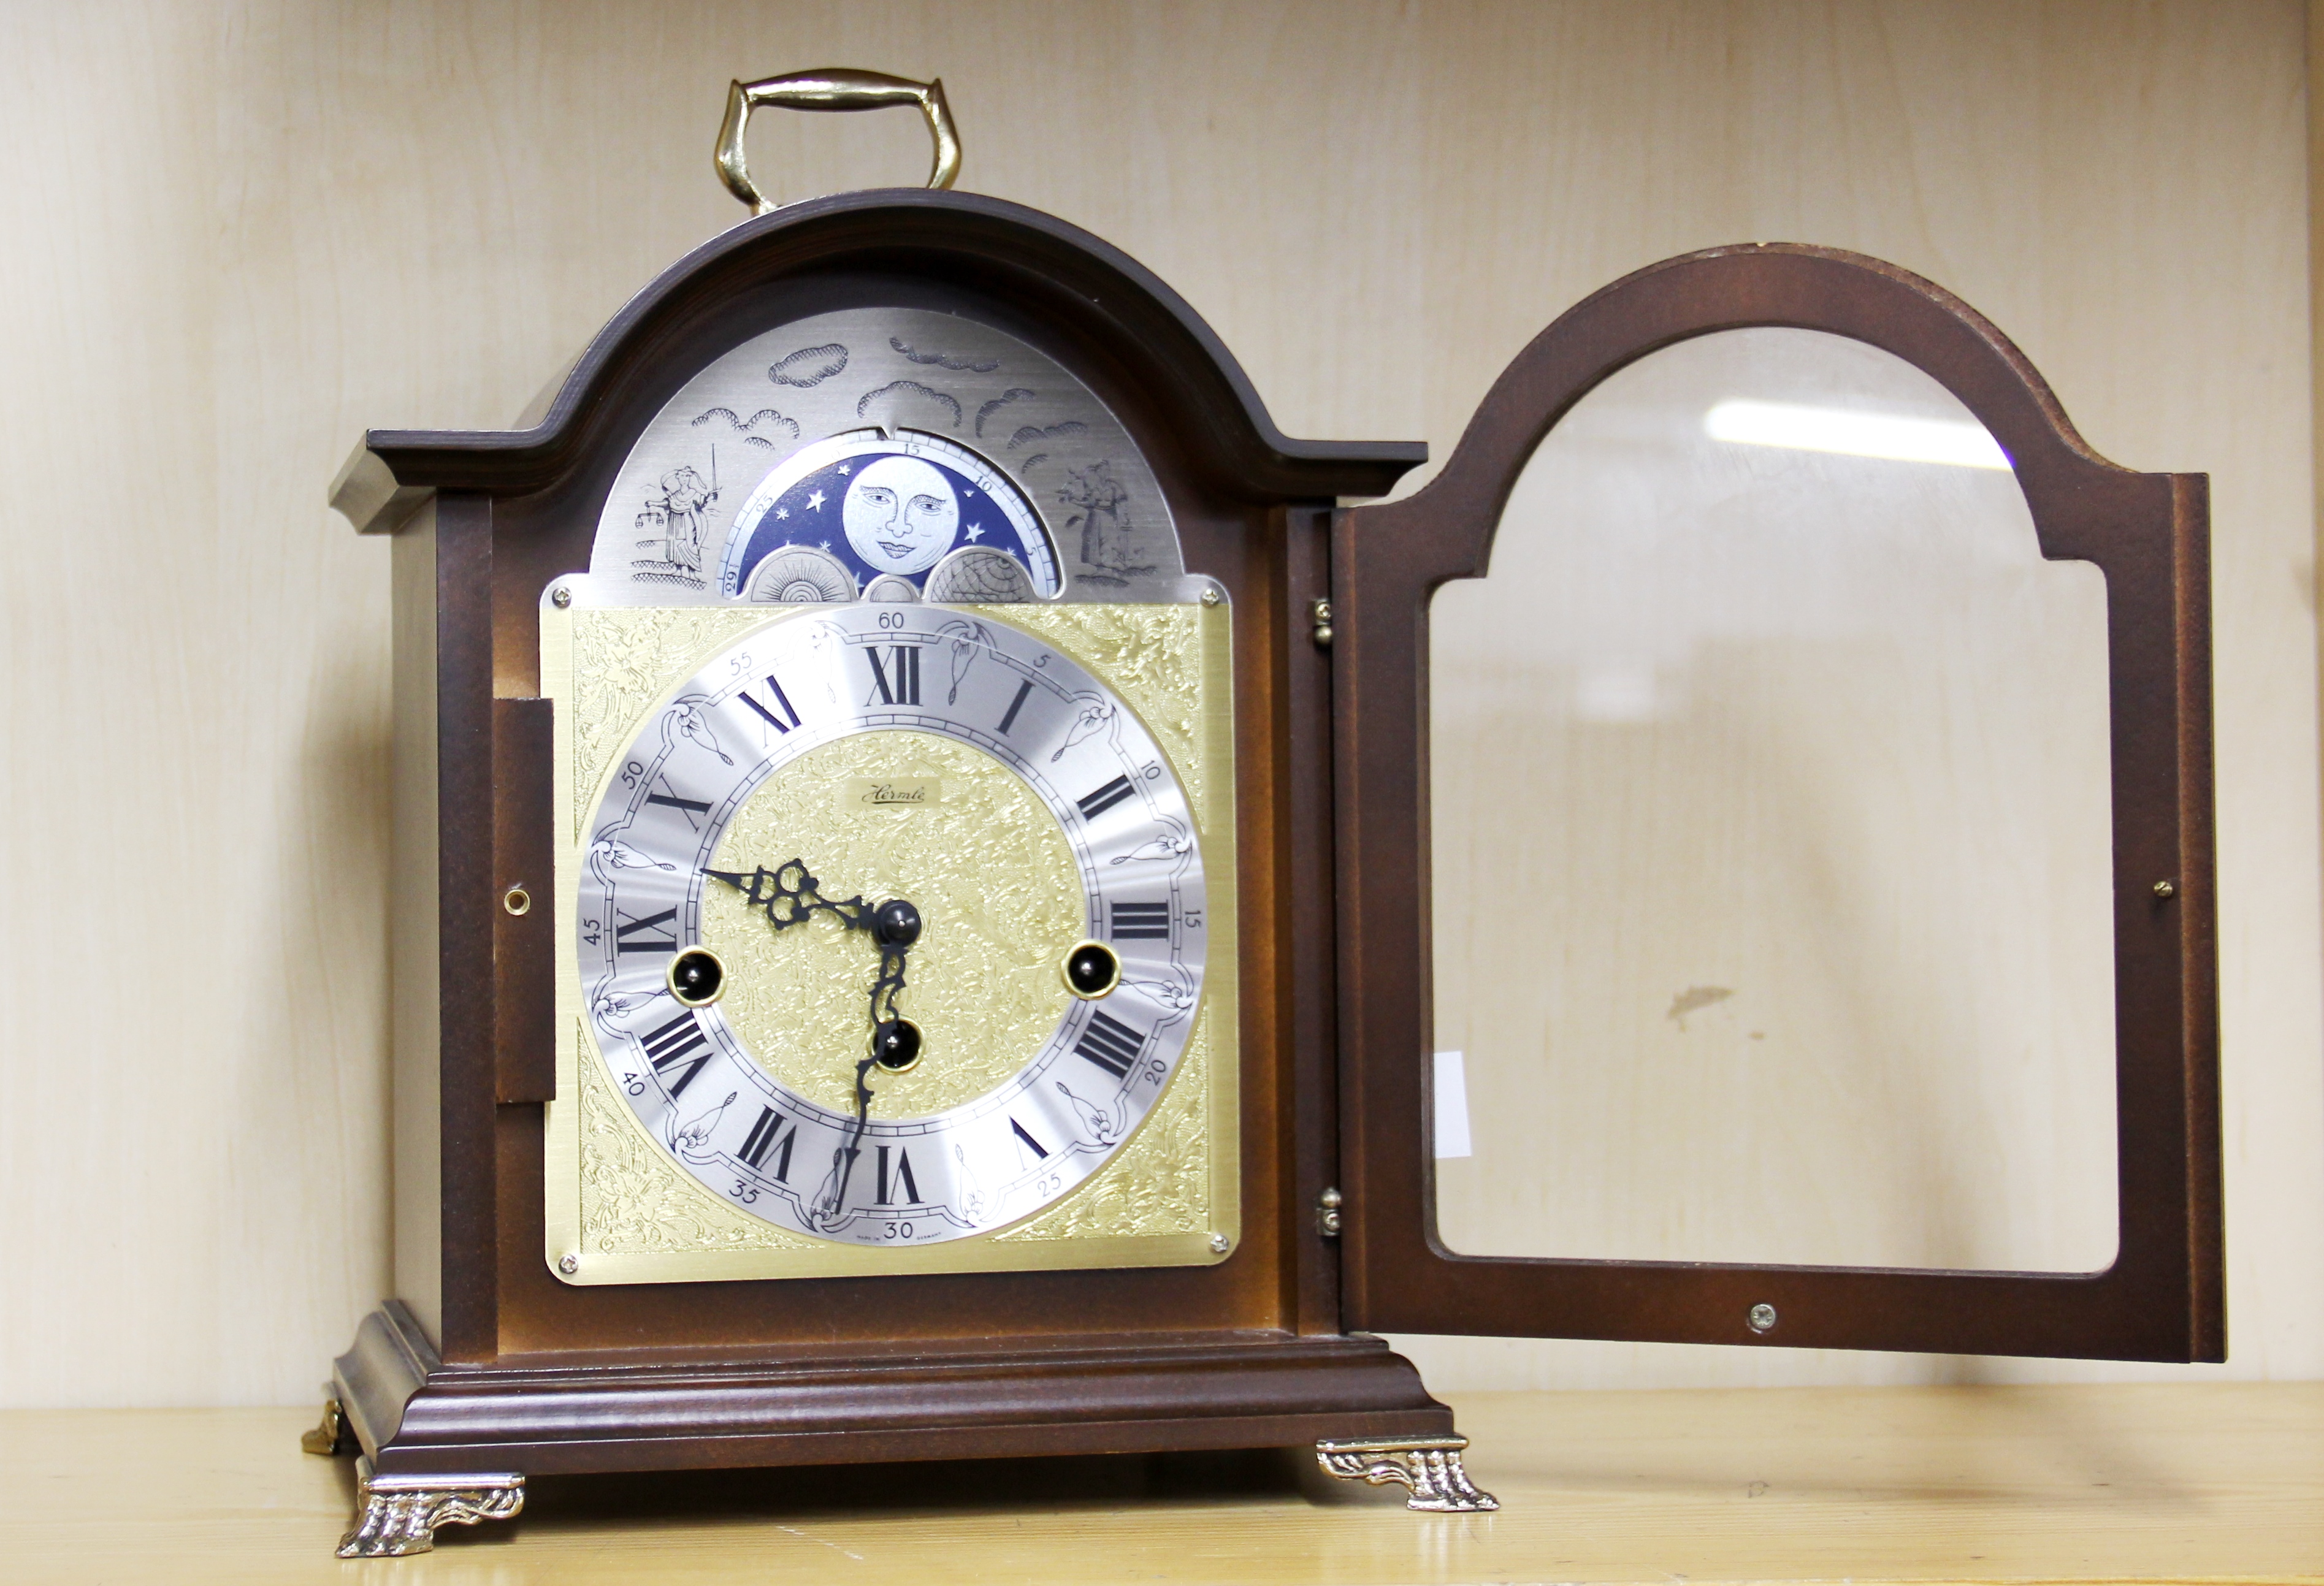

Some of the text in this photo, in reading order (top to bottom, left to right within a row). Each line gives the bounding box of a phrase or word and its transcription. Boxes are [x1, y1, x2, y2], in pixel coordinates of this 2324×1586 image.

[904, 443, 920, 455] 15
[974, 476, 992, 491] 10
[755, 496, 774, 513] 25
[1026, 547, 1036, 556] 5
[879, 612, 904, 629] 60
[730, 652, 752, 676] 55
[1033, 654, 1050, 668] 5
[863, 645, 923, 707] XII
[735, 675, 803, 749] XI
[994, 678, 1036, 738] I
[621, 761, 644, 790] 50
[1141, 760, 1161, 780] 10
[645, 772, 714, 834] X
[862, 784, 925, 804] Hermle
[1074, 771, 1137, 825] II
[583, 919, 600, 945] 45
[616, 904, 678, 957] IX
[1110, 899, 1169, 943] III
[1185, 909, 1201, 929] 15
[638, 1008, 714, 1103] VIII
[1071, 1005, 1147, 1081] IIII
[621, 1072, 646, 1096] 40
[1145, 1060, 1166, 1086] 20
[733, 1104, 798, 1184] VII
[1007, 1115, 1053, 1172] V
[873, 1145, 925, 1205] VI
[1037, 1172, 1062, 1197] 25
[728, 1180, 759, 1203] 35
[884, 1222, 913, 1239] 30
